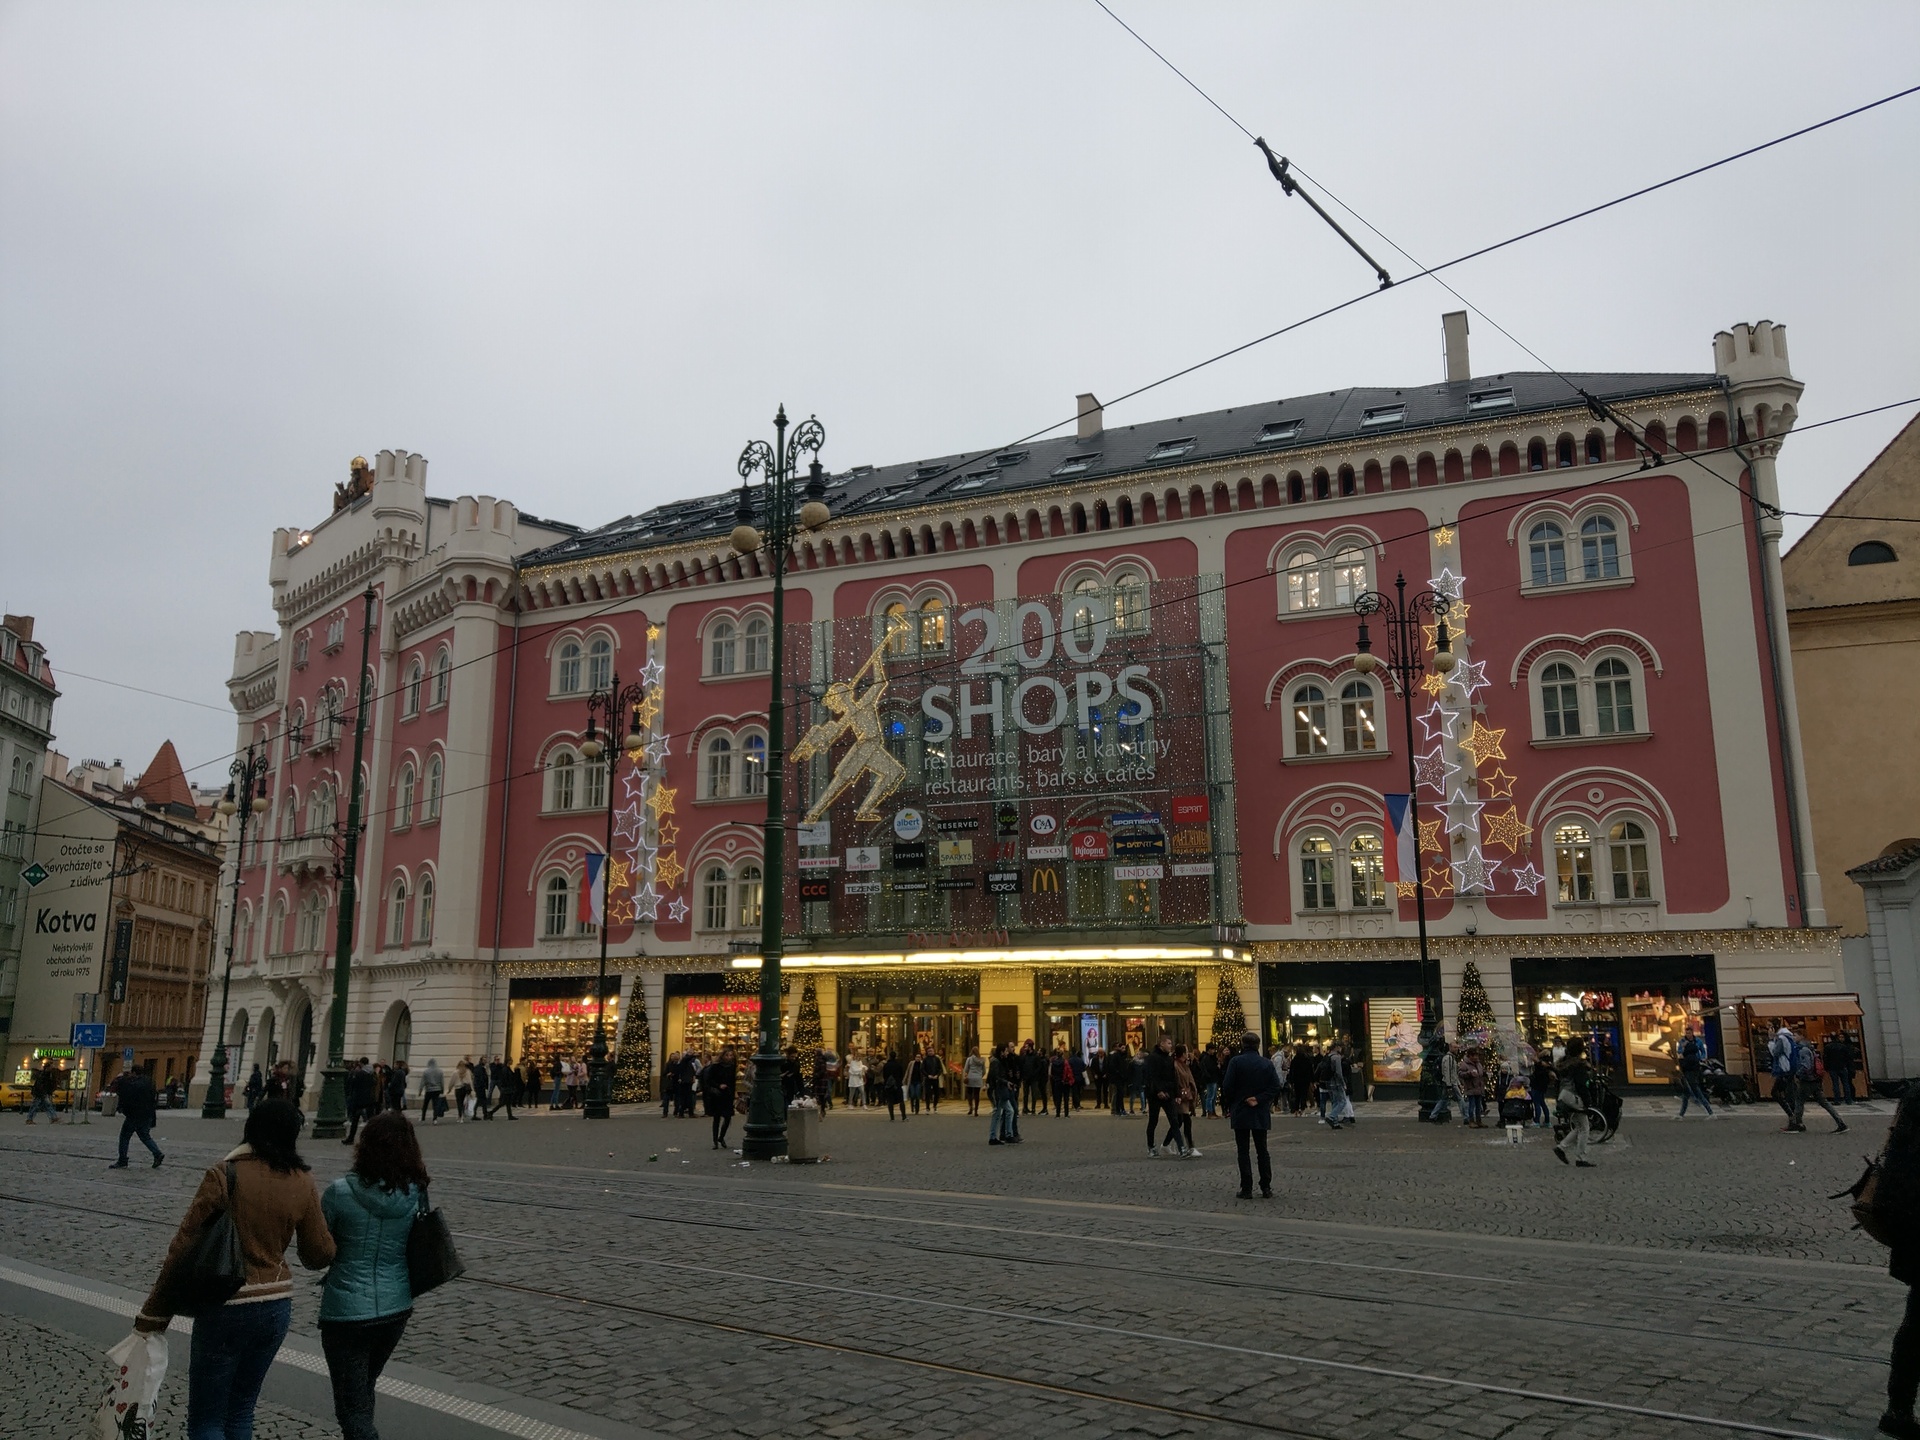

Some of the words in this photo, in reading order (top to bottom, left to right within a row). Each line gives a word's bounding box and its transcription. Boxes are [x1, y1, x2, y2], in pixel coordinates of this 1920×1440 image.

[958, 596, 1107, 675] 200
[921, 665, 1153, 742] SHOPS
[924, 747, 1021, 770] restaurace,
[1028, 744, 1068, 767] bary
[1077, 746, 1087, 758] a
[1094, 738, 1171, 758] kavárny
[925, 774, 1030, 796] restaurants,
[1037, 768, 1076, 787] bars
[1084, 766, 1098, 784] &
[1105, 763, 1156, 783] cafés
[1178, 805, 1204, 814] ESPRIT
[896, 818, 919, 826] albert
[937, 821, 979, 830] RESERVED
[1034, 818, 1053, 830] C&A
[61, 843, 92, 856] Otočte
[94, 845, 105, 854] se
[1030, 847, 1064, 856] orsay
[1075, 846, 1104, 857] Výtopna
[894, 852, 924, 860] SEPHORA
[988, 873, 1002, 882] CAMP
[1003, 872, 1018, 881] DAVID
[1117, 868, 1160, 878] LINDEX
[70, 879, 76, 887] z
[846, 884, 880, 893] TEZENIS
[802, 885, 827, 896] CCC
[35, 908, 97, 934] Kotva
[908, 930, 1010, 948] PALLADIUM
[46, 954, 76, 965] obchodní
[77, 954, 92, 965] dům
[50, 969, 60, 977] od
[60, 968, 75, 977] roku
[75, 967, 90, 976] 1975
[533, 1001, 559, 1014] Foot
[688, 998, 719, 1013] Foot
[1538, 1002, 1578, 1016] PUMA
[39, 1048, 75, 1058] RESTAURANT
